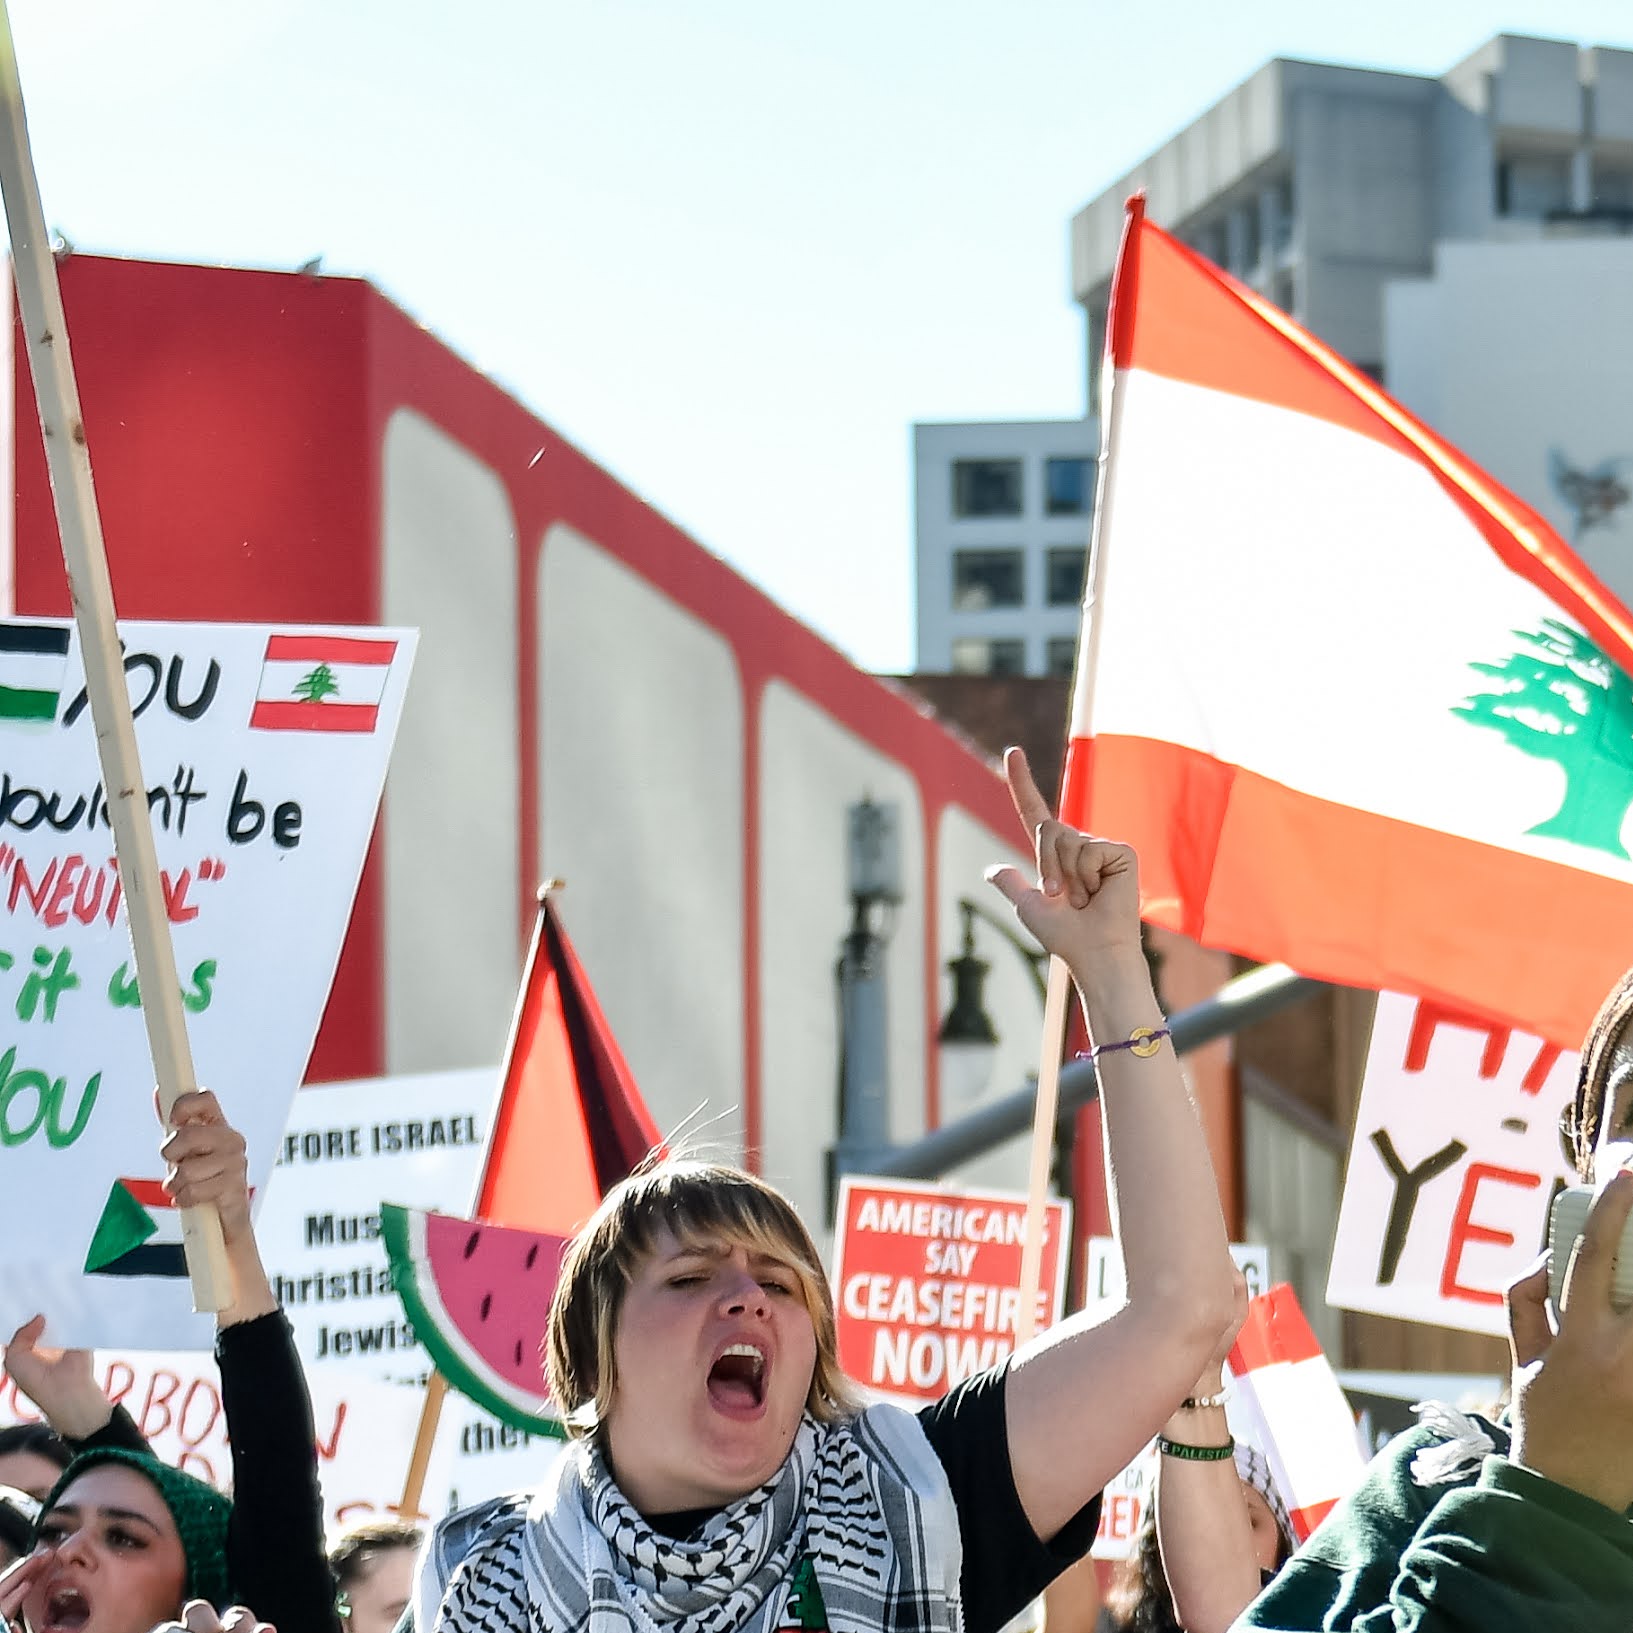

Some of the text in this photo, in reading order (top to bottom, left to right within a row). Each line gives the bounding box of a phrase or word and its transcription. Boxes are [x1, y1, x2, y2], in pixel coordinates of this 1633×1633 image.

[0, 763, 302, 848] ouln't be
[0, 841, 226, 929] "NEUTL"
[15, 944, 218, 1024] it ws
[276, 1116, 478, 1165] FORE ISRAEL
[924, 1240, 978, 1278] SAY
[276, 1266, 396, 1305] hristia
[317, 1320, 418, 1358] Jewis
[1171, 1443, 1234, 1461] PALESTIN
